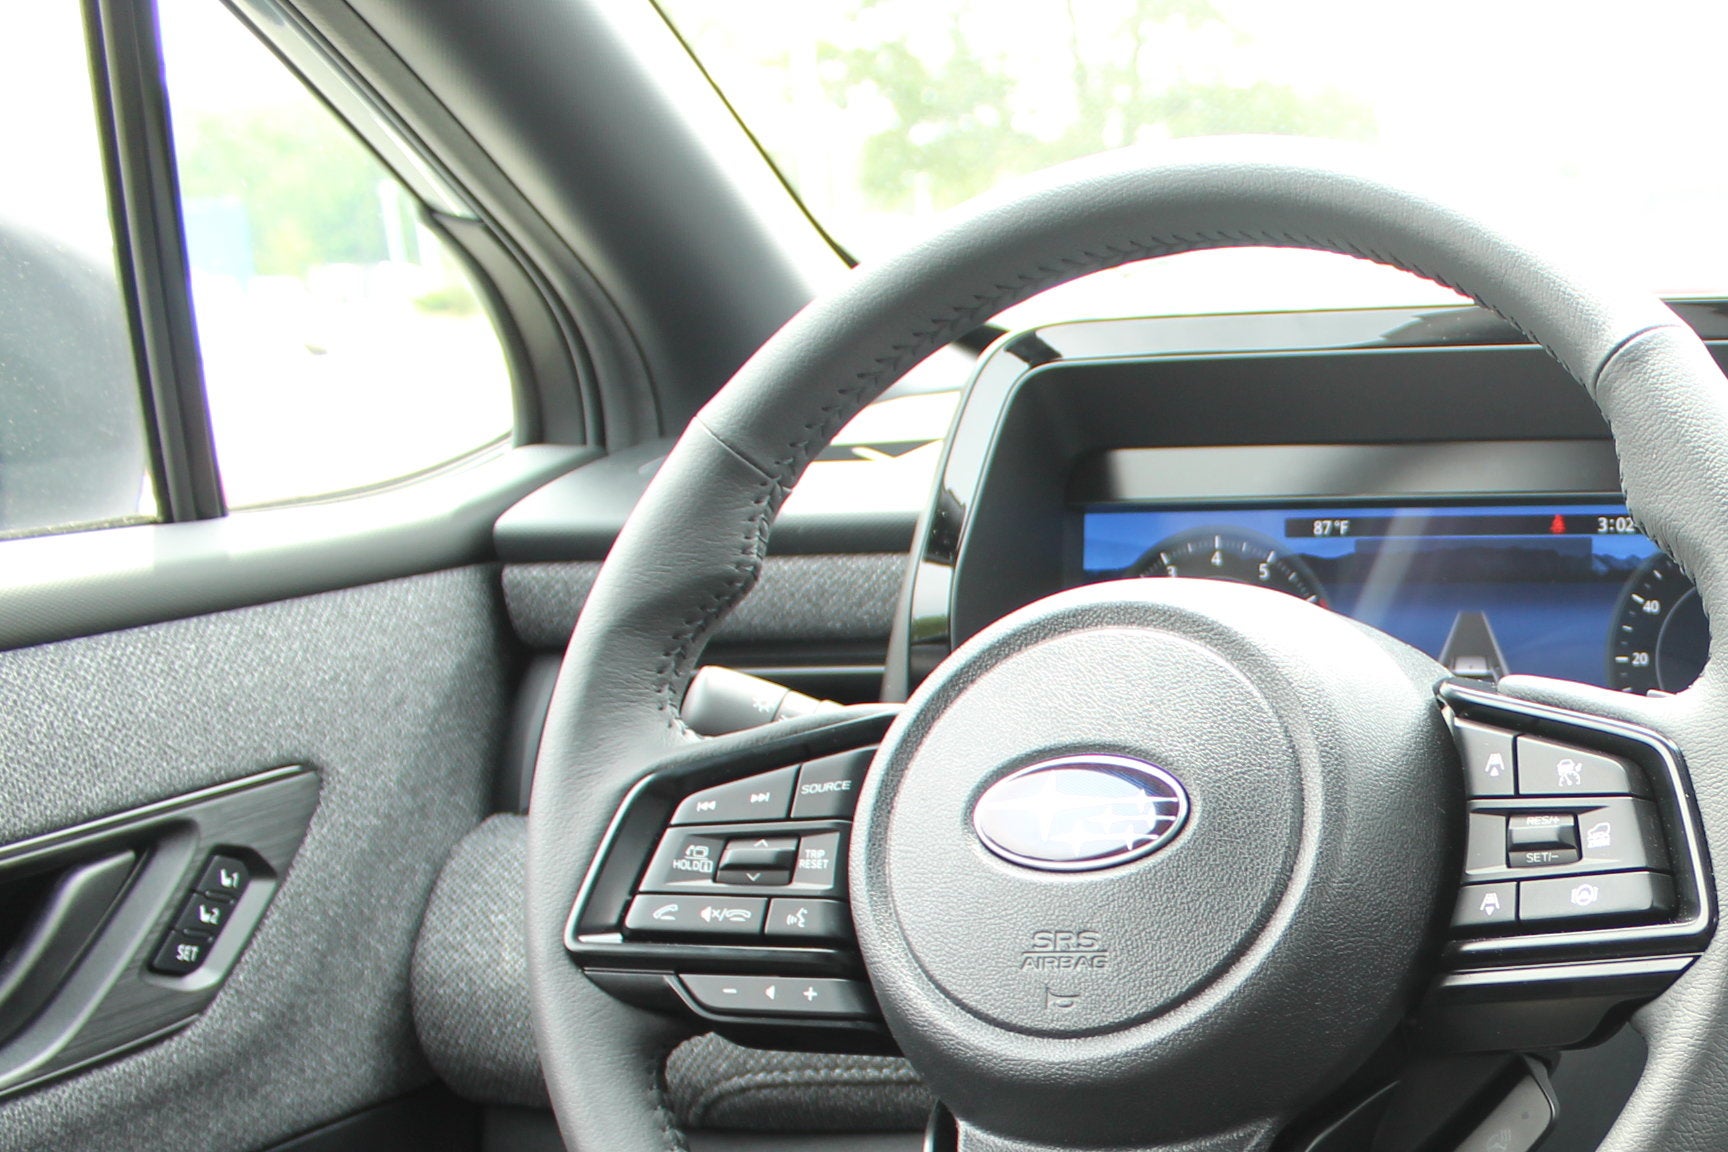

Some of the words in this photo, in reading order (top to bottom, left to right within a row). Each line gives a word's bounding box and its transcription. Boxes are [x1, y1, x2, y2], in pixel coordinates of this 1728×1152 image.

[1598, 517, 1635, 532] 3:02
[1211, 551, 1222, 566] 4
[1258, 563, 1270, 579] 5
[1642, 600, 1660, 614] 40
[1631, 652, 1649, 667] 20
[801, 780, 852, 795] SOURCE
[805, 848, 826, 860] TRIP
[673, 859, 699, 871] HOLD
[799, 859, 830, 870] RESET
[1032, 930, 1101, 952] SRS
[176, 943, 199, 962] SET
[1020, 955, 1108, 970] AIRBAG
